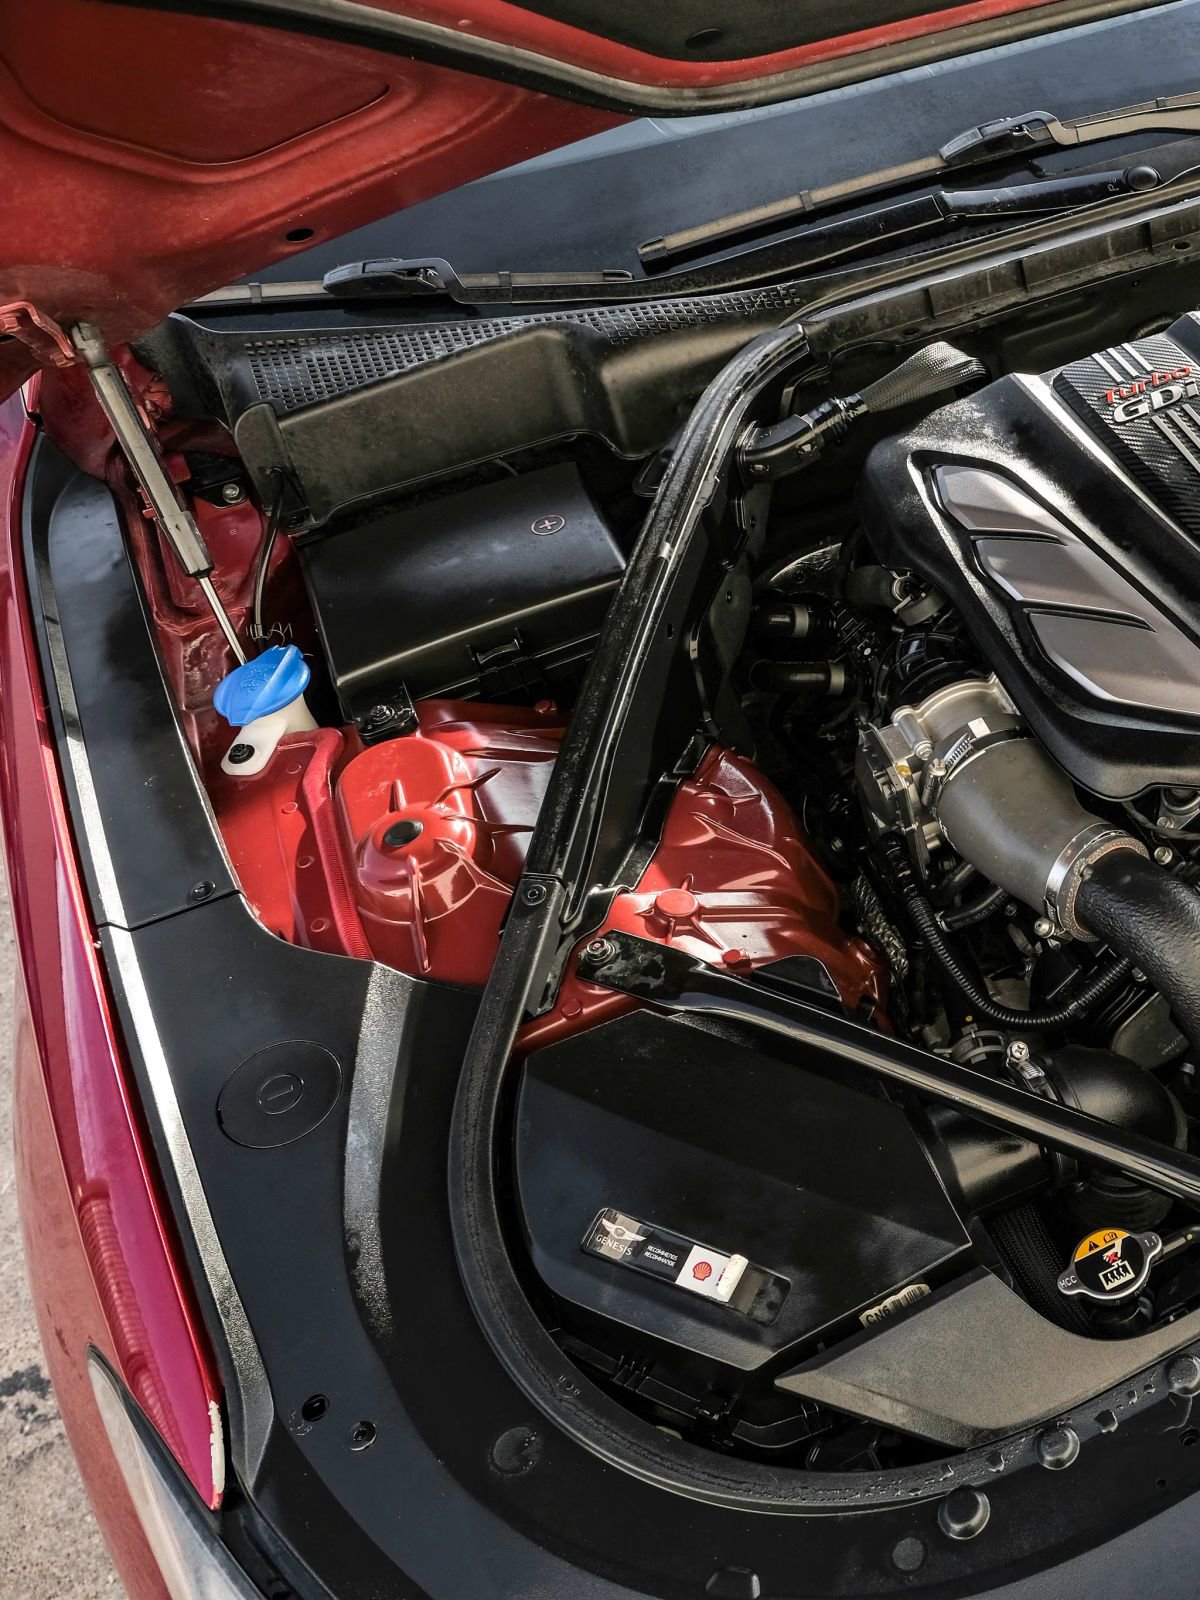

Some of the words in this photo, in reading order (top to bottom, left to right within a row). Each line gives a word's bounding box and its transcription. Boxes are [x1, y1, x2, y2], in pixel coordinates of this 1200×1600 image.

[1102, 367, 1191, 404] Turbo
[1113, 378, 1199, 423] GDi
[595, 1234, 633, 1257] GENESIS
[1059, 1275, 1078, 1289] HCC
[865, 1305, 891, 1325] CN6
